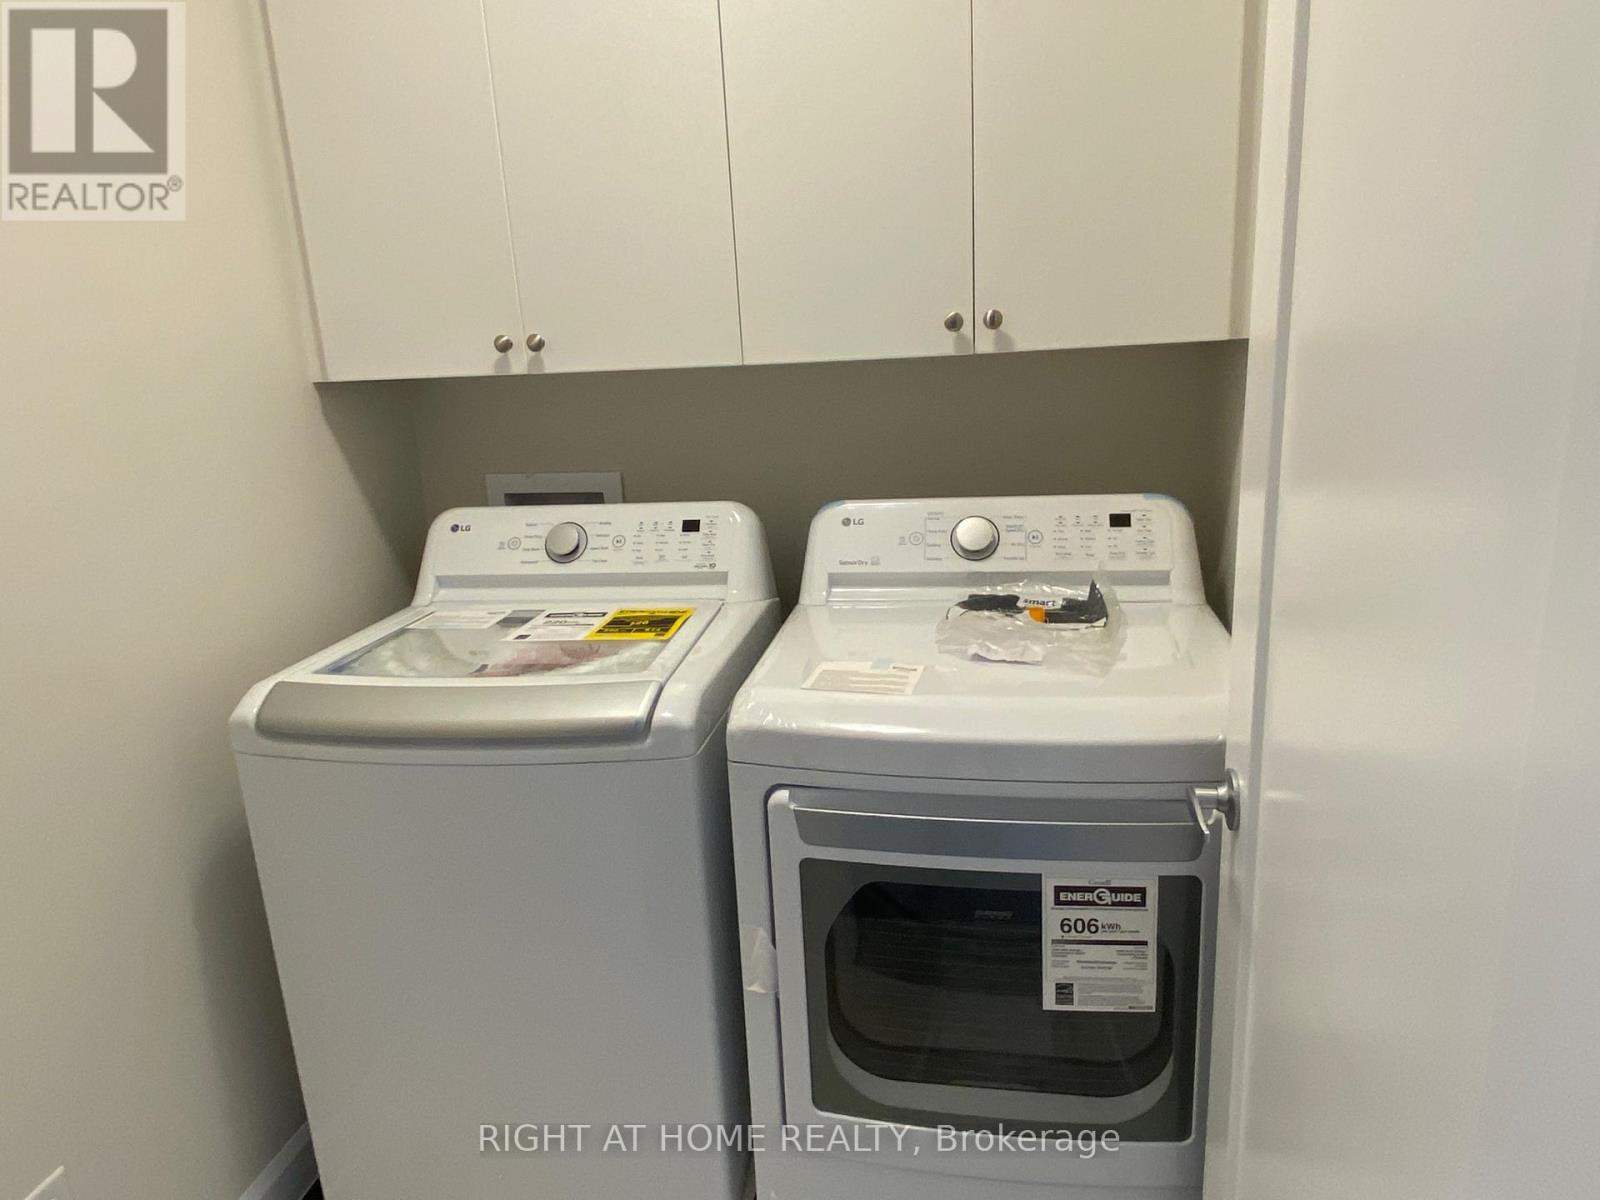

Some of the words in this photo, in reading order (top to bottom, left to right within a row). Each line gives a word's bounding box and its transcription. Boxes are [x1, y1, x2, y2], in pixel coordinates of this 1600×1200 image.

[852, 518, 864, 526] LG
[1059, 888, 1141, 905] ENERGUIDE
[1060, 917, 1099, 934] 606
[1101, 922, 1121, 930] kWh
